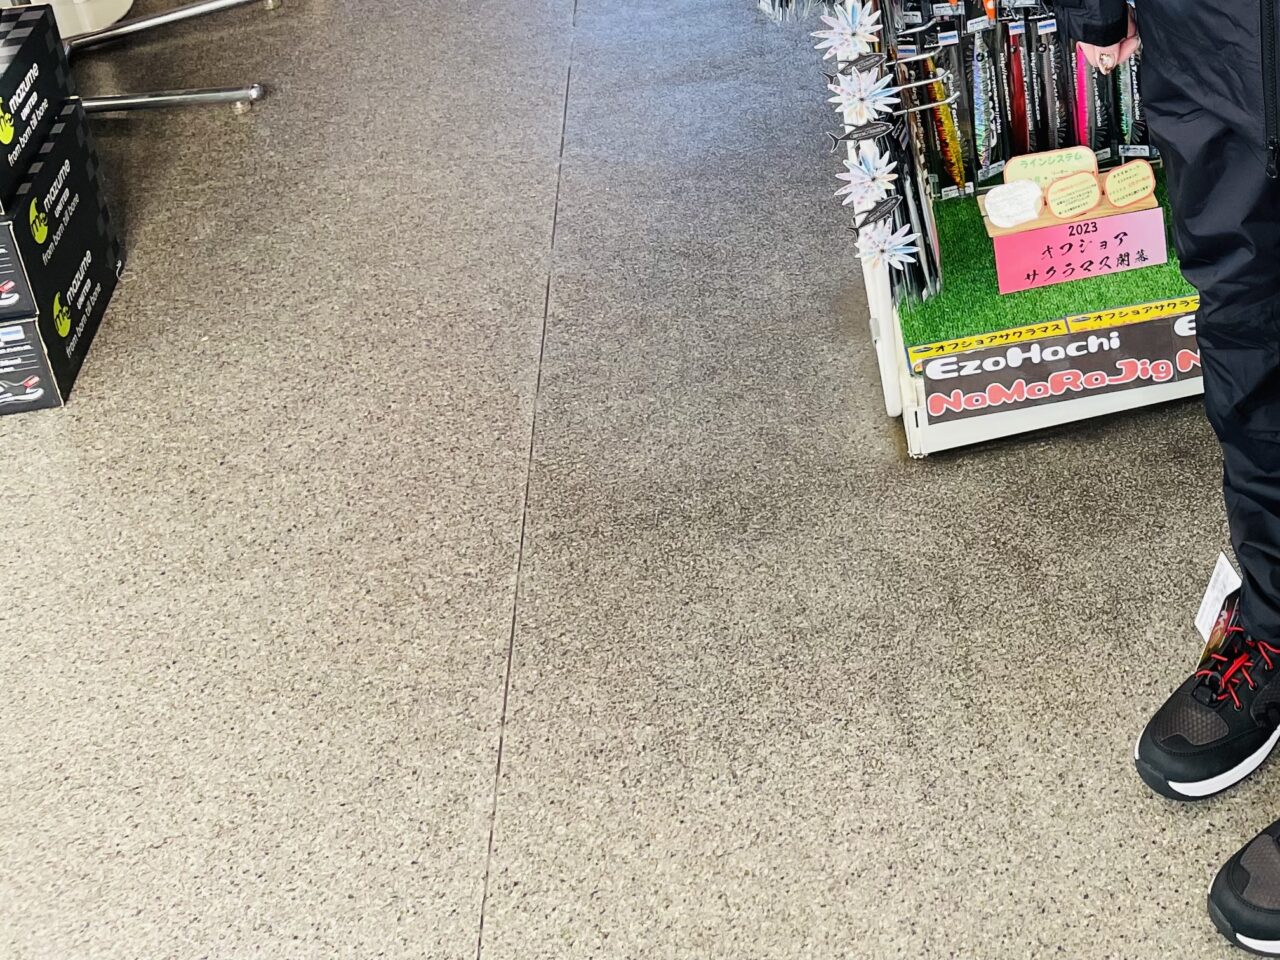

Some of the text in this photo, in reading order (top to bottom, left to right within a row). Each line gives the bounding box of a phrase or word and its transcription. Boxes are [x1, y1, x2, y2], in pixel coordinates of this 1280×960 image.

[8, 62, 39, 114] mazume
[20, 91, 38, 122] UNITED
[1130, 53, 1141, 120] ingTackleStudio
[7, 98, 49, 167] from born till bone
[43, 158, 71, 212] mazume
[1020, 152, 1083, 168] ラインシステム
[42, 193, 80, 266] from born till bone
[1041, 231, 1128, 261] オフショア
[1068, 221, 1098, 237] 2023
[66, 249, 92, 306] mazume
[1024, 250, 1149, 285] サクラマス開幕
[65, 282, 102, 359] from born till bone
[934, 323, 1062, 353] オフショアサクラマス
[926, 331, 1121, 381] EzoHachi
[927, 358, 1174, 417] NaMaRaJig
